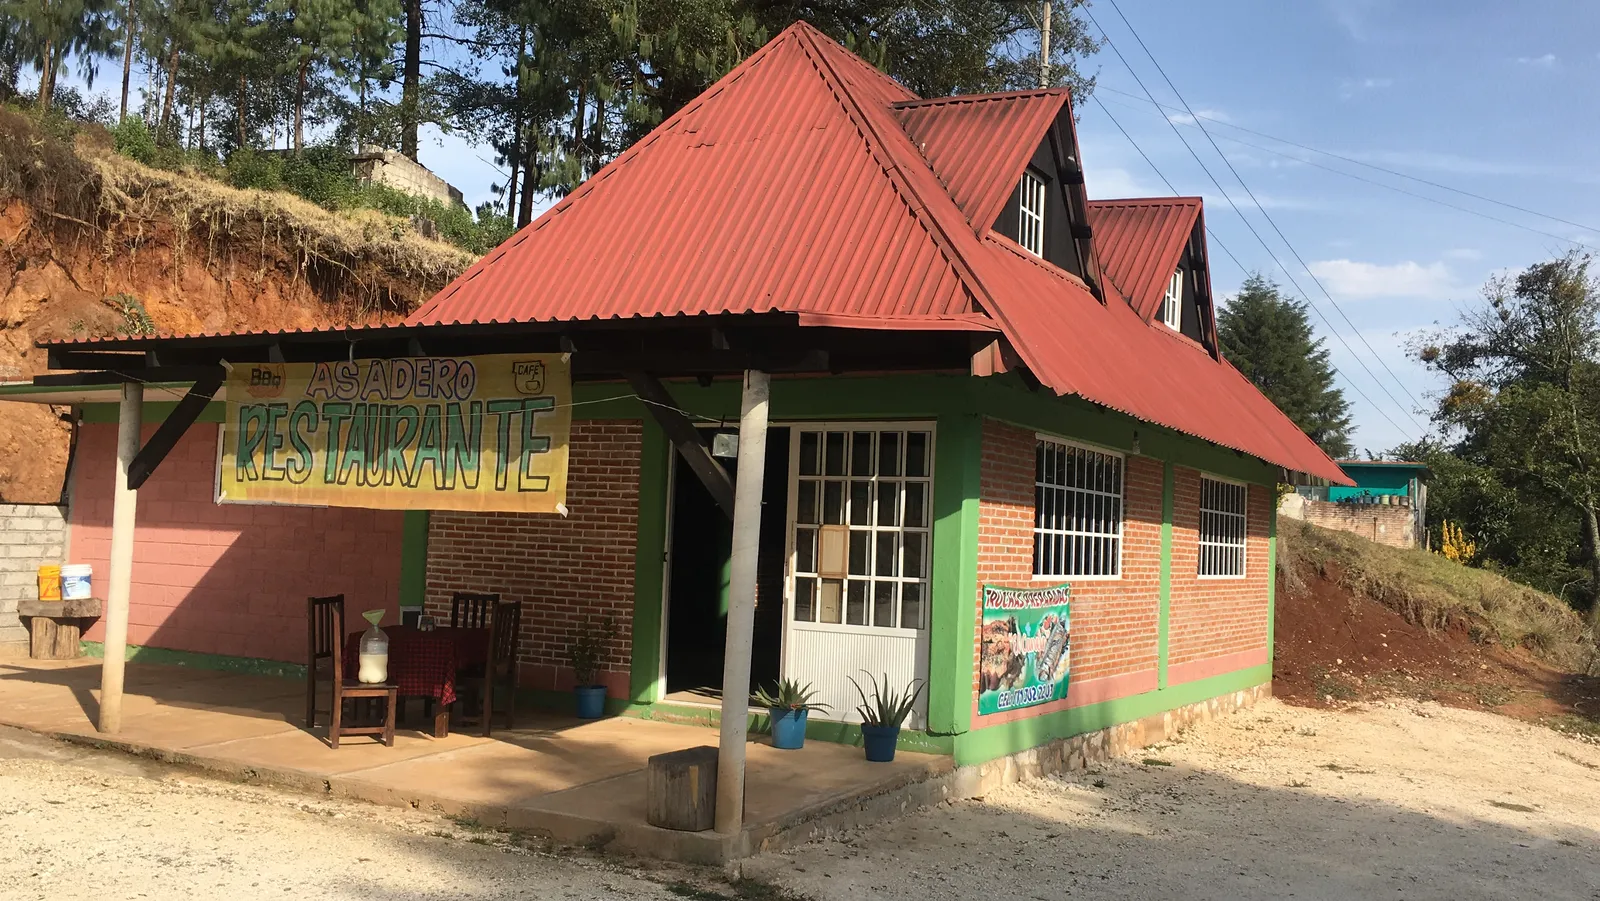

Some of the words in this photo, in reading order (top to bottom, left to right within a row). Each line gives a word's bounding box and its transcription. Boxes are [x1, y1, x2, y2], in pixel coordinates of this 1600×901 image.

[307, 358, 478, 401] ASADERO
[236, 397, 555, 492] RESTAURANTE
[985, 588, 1024, 609] TRUCHAS
